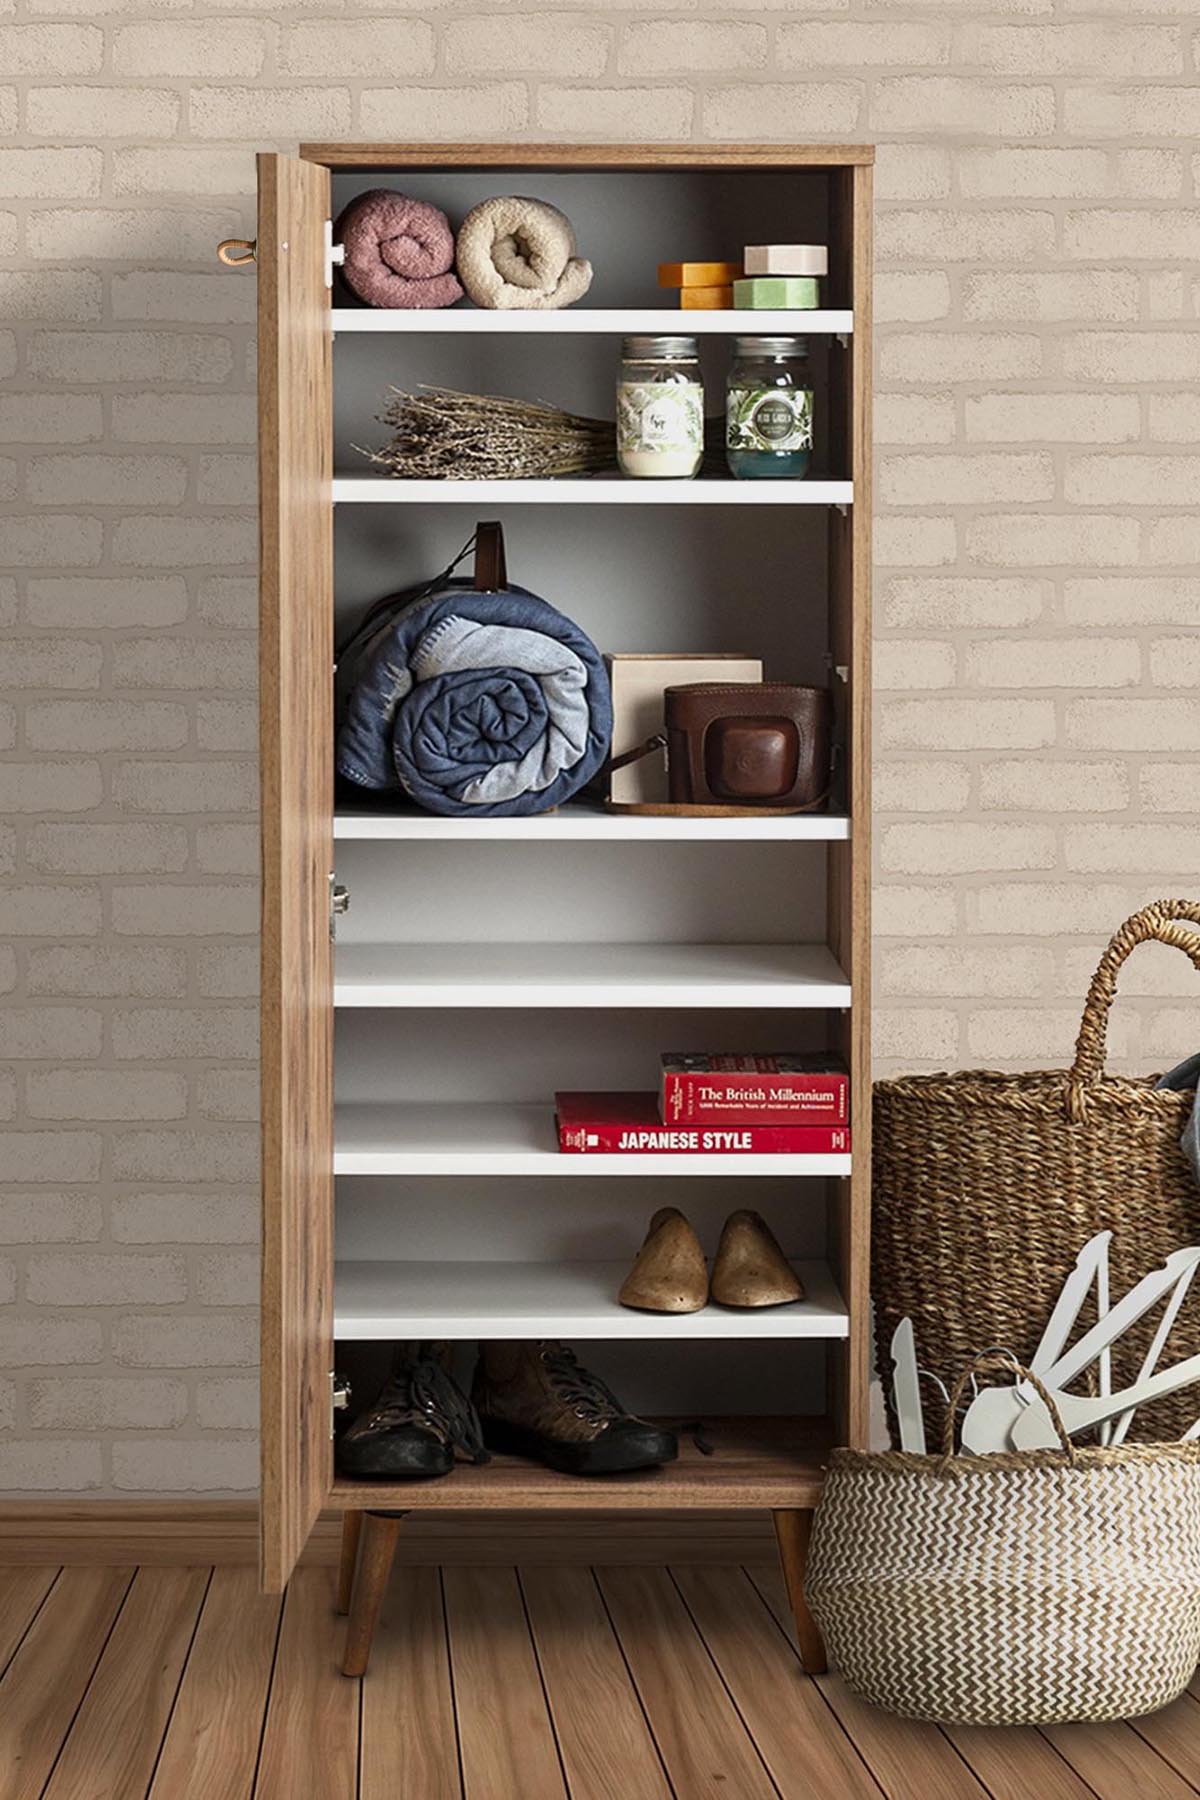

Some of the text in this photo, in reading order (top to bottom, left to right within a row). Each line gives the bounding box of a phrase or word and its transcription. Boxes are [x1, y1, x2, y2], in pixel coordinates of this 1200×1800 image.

[698, 1087, 834, 1101] The British Millennium
[618, 1132, 752, 1149] JAPANESE STYLE
